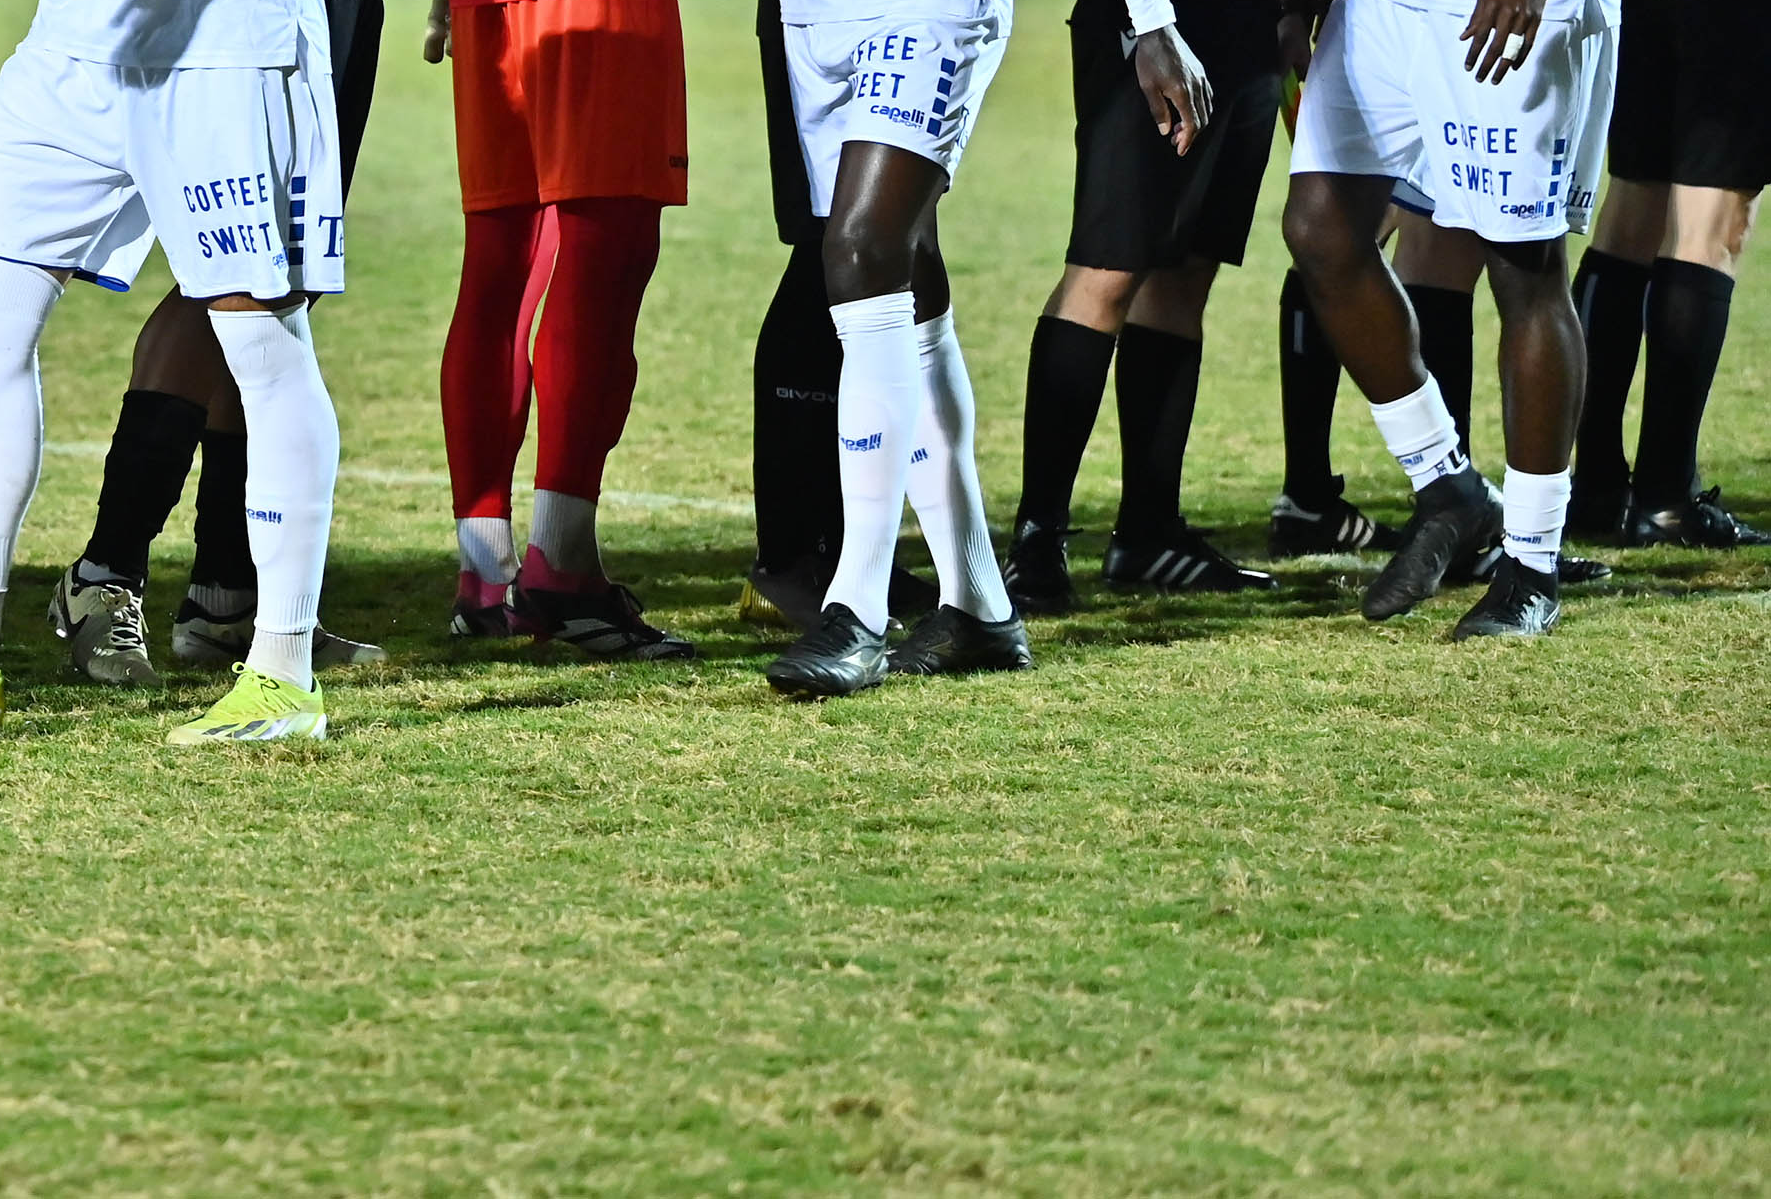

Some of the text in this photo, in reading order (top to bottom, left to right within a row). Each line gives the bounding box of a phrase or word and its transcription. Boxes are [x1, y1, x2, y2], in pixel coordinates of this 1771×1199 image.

[869, 104, 926, 125] capelli
[183, 173, 269, 214] COFFEE
[1499, 200, 1545, 218] capelli
[197, 222, 272, 259] SWEET
